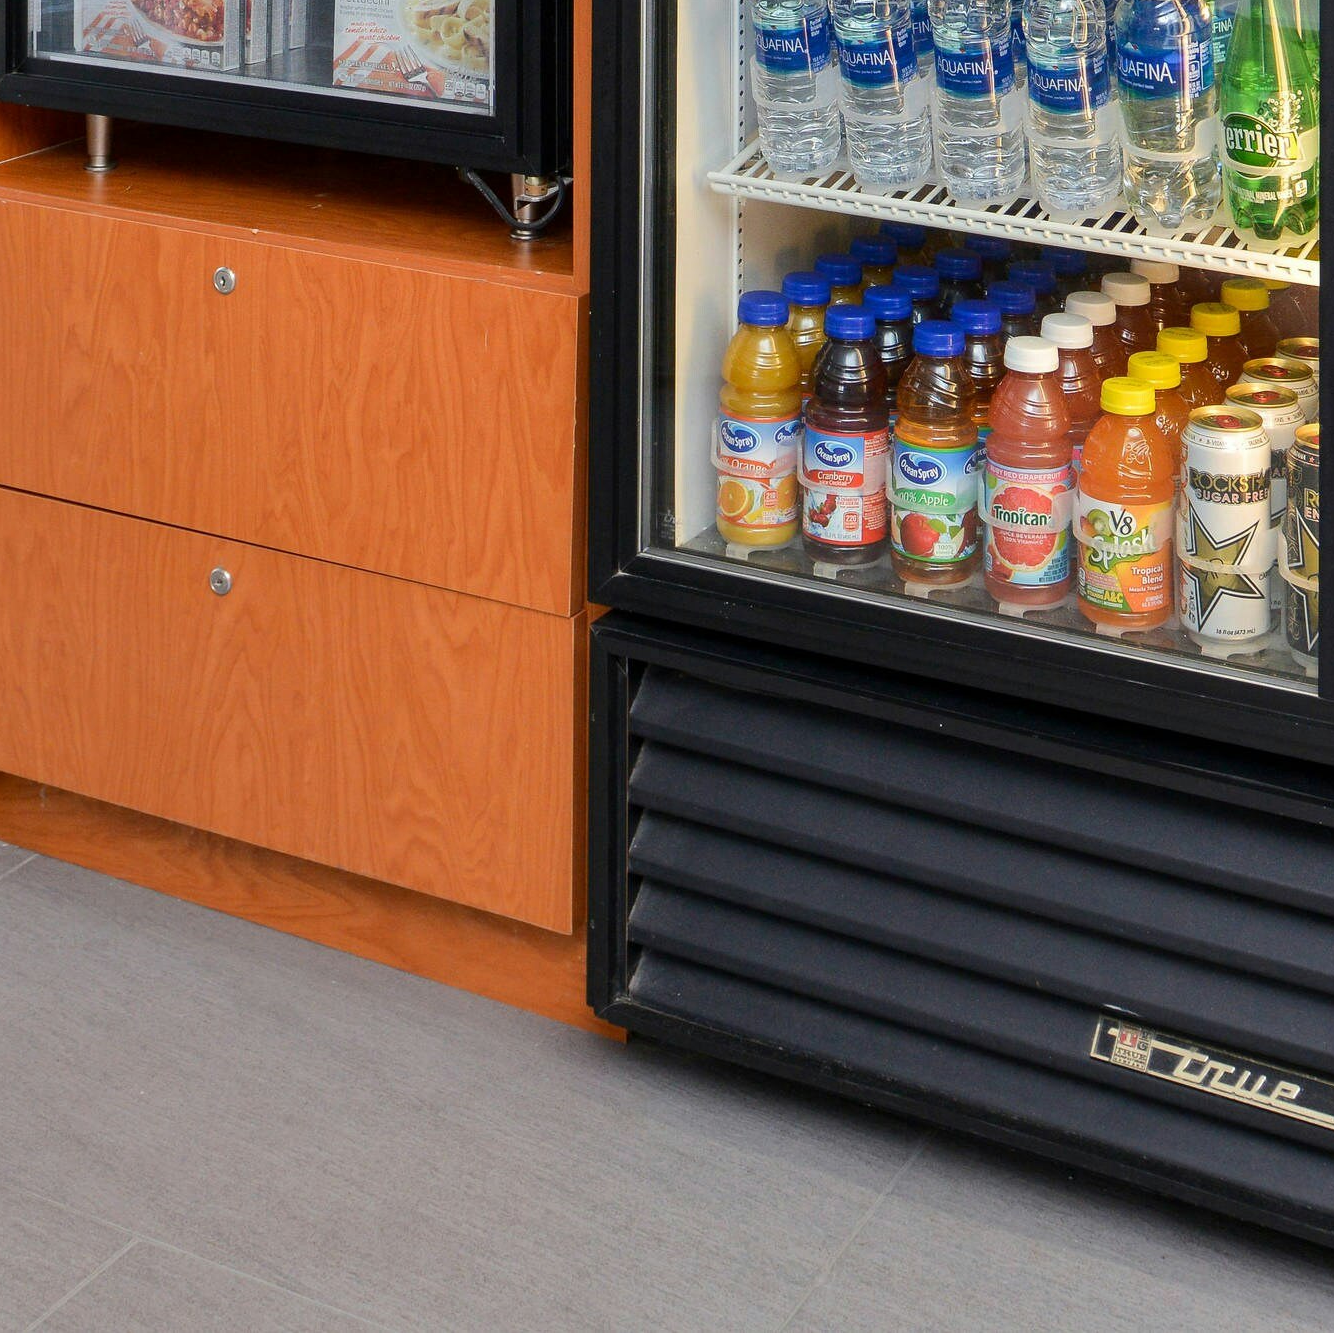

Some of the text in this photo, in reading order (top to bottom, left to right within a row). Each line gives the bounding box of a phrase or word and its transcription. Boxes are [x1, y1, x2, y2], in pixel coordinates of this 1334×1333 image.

[937, 55, 993, 77] AQUAFINA
[1030, 68, 1086, 93] AQUAFINA
[817, 446, 851, 464] Ocean Spray
[731, 459, 767, 475] Orange
[900, 459, 939, 481] Ocean Spray
[1003, 469, 1018, 479] RED
[1018, 471, 1061, 481] GRAPEFRUIT
[817, 471, 854, 484] Cranberry
[918, 494, 949, 506] Apple
[1196, 488, 1269, 504] SUGAR FREE
[1109, 509, 1133, 536] V8
[1131, 563, 1163, 575] Tropical
[1142, 575, 1163, 584] Blend
